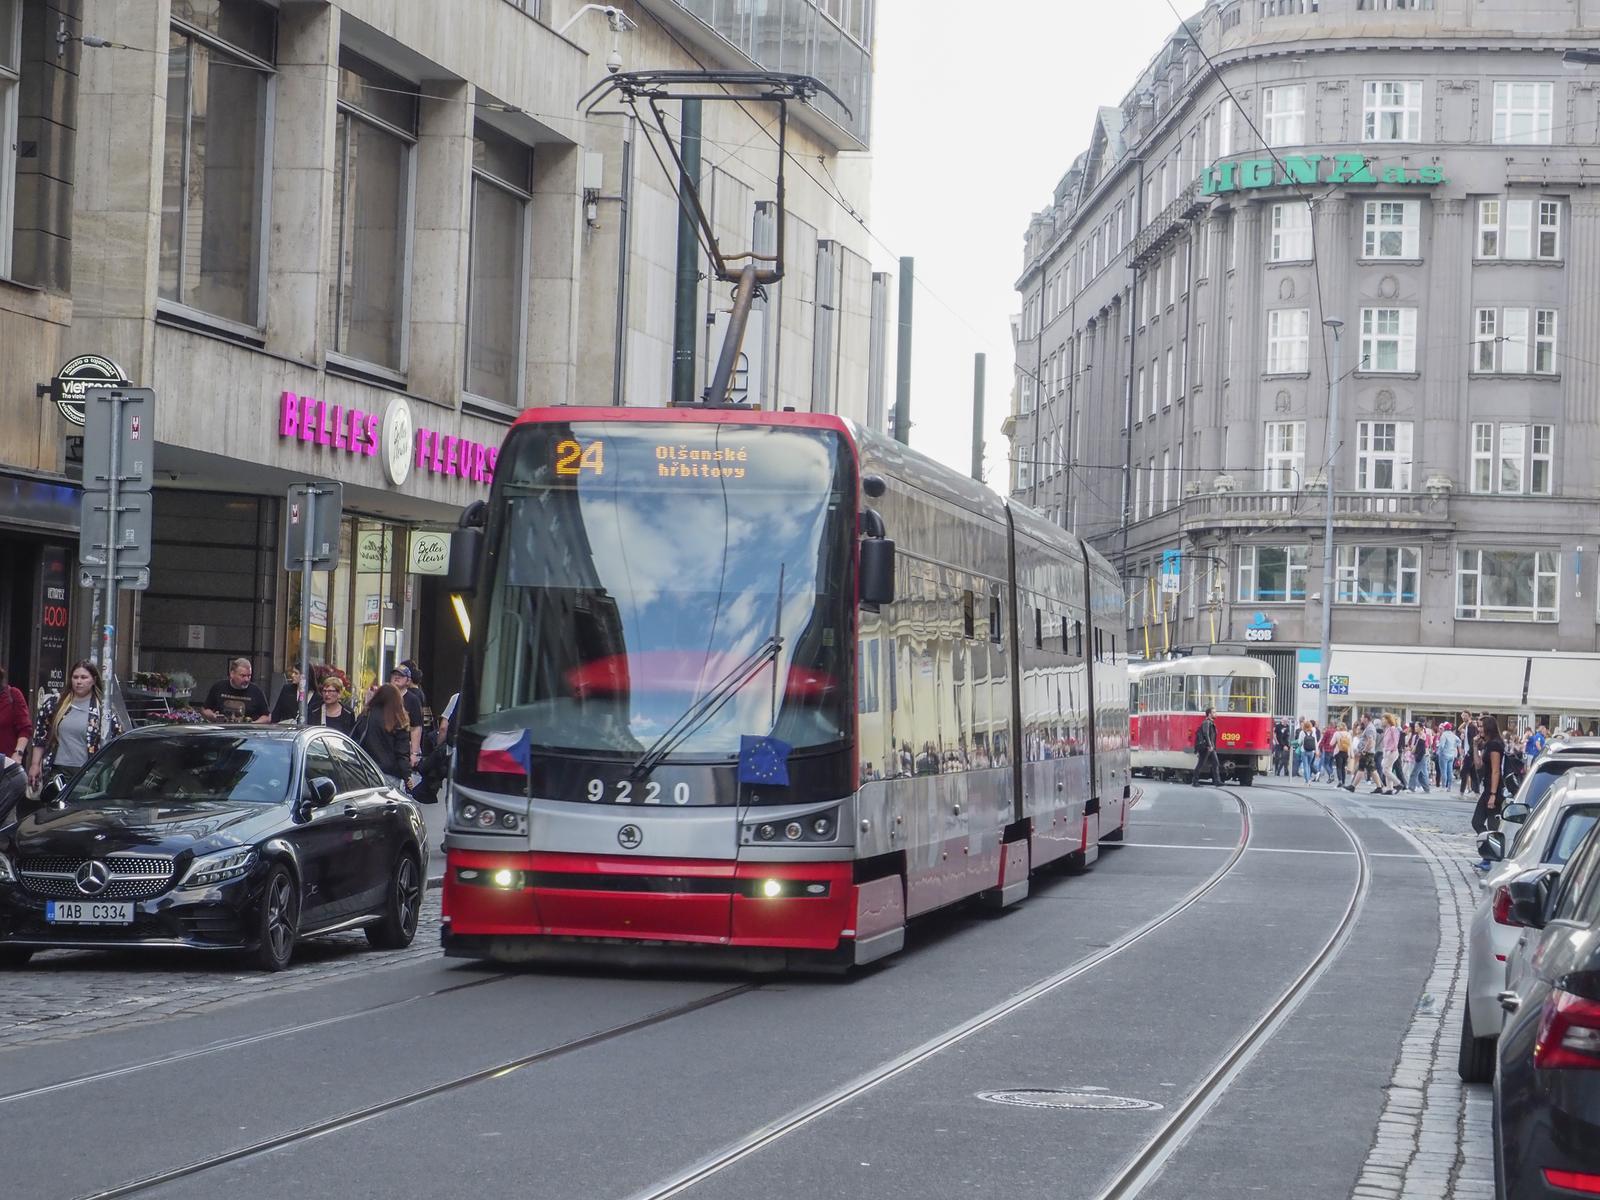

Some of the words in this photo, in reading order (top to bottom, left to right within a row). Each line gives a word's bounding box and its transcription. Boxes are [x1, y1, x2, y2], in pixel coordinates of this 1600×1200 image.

[1200, 154, 1377, 196] LIGNA
[279, 391, 379, 456] BELLES
[416, 428, 500, 484] FLEURS
[556, 440, 604, 475] 24
[655, 445, 747, 462] Olšanské
[657, 462, 745, 478] hřbitovy
[418, 541, 442, 554] Belles
[417, 553, 445, 564] fleurs
[1221, 733, 1240, 741] 8399
[587, 779, 690, 804] 9220
[59, 904, 82, 919] 1AB
[92, 905, 127, 919] C334
